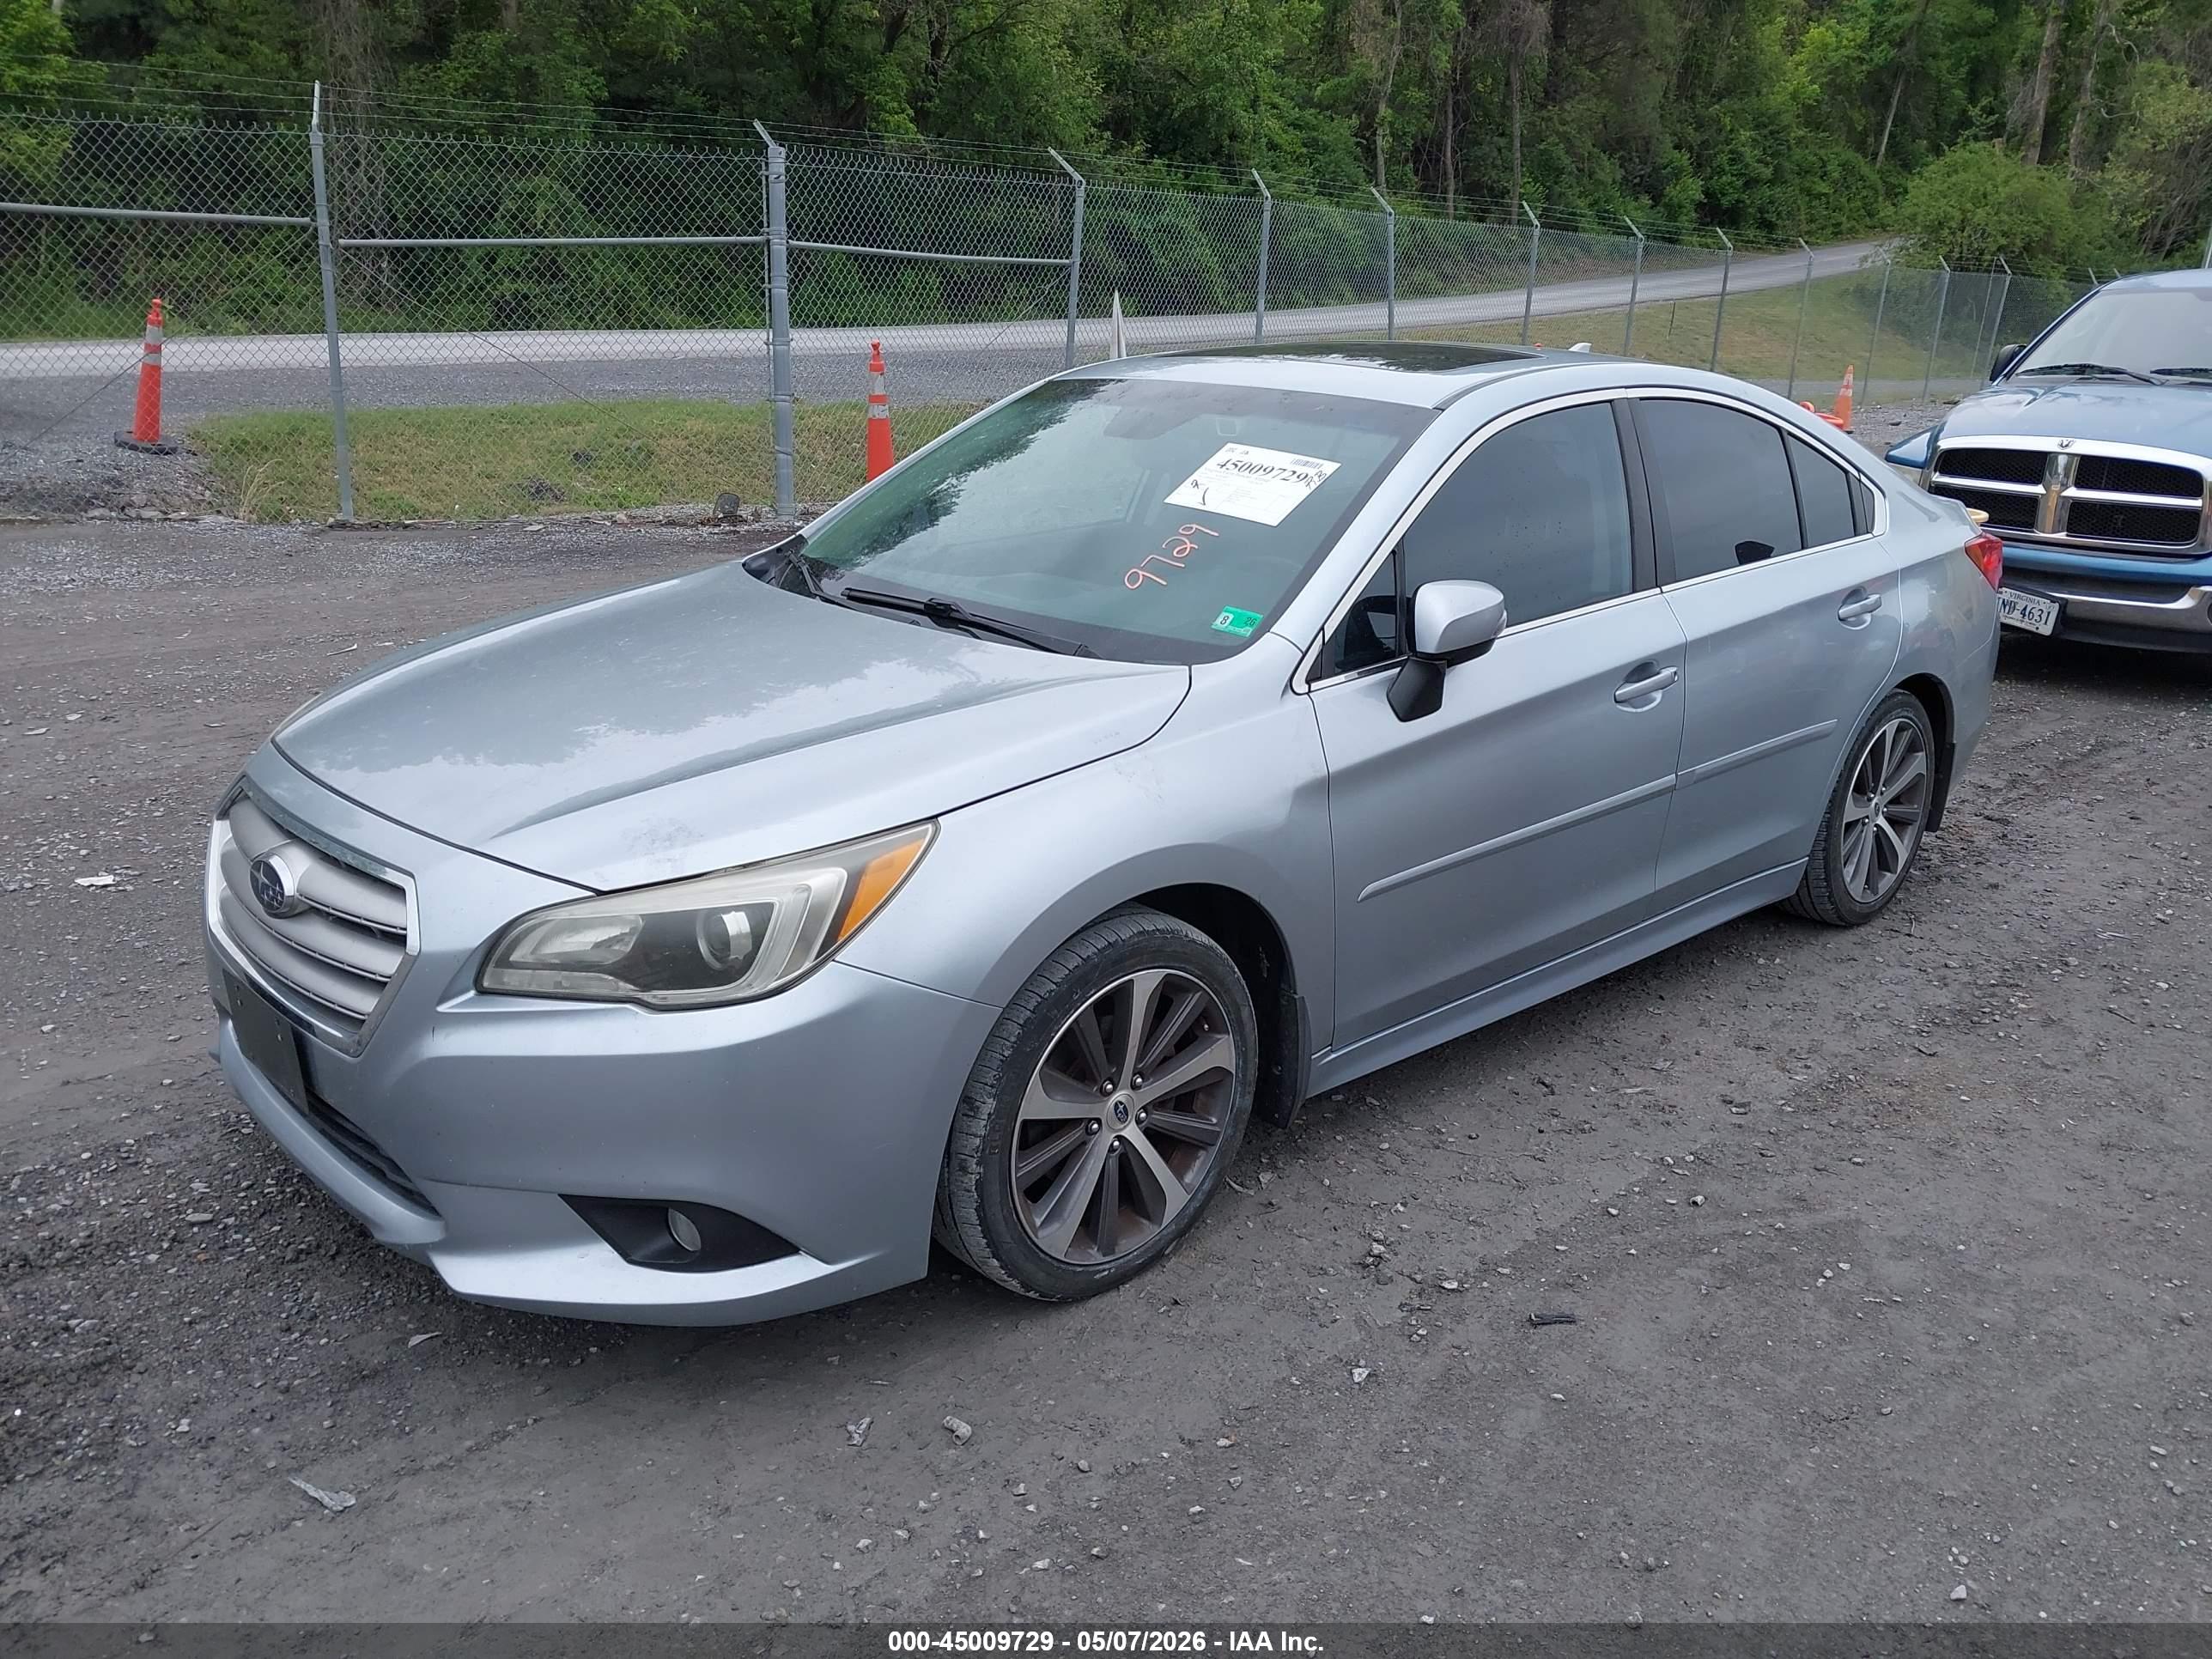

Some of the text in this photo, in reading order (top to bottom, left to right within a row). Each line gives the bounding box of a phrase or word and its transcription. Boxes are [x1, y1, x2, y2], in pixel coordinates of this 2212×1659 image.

[1217, 459, 1309, 483] 45009729
[1124, 524, 1219, 589] 9729
[2009, 591, 2041, 606] VIRGINIA
[1220, 615, 1230, 625] 8
